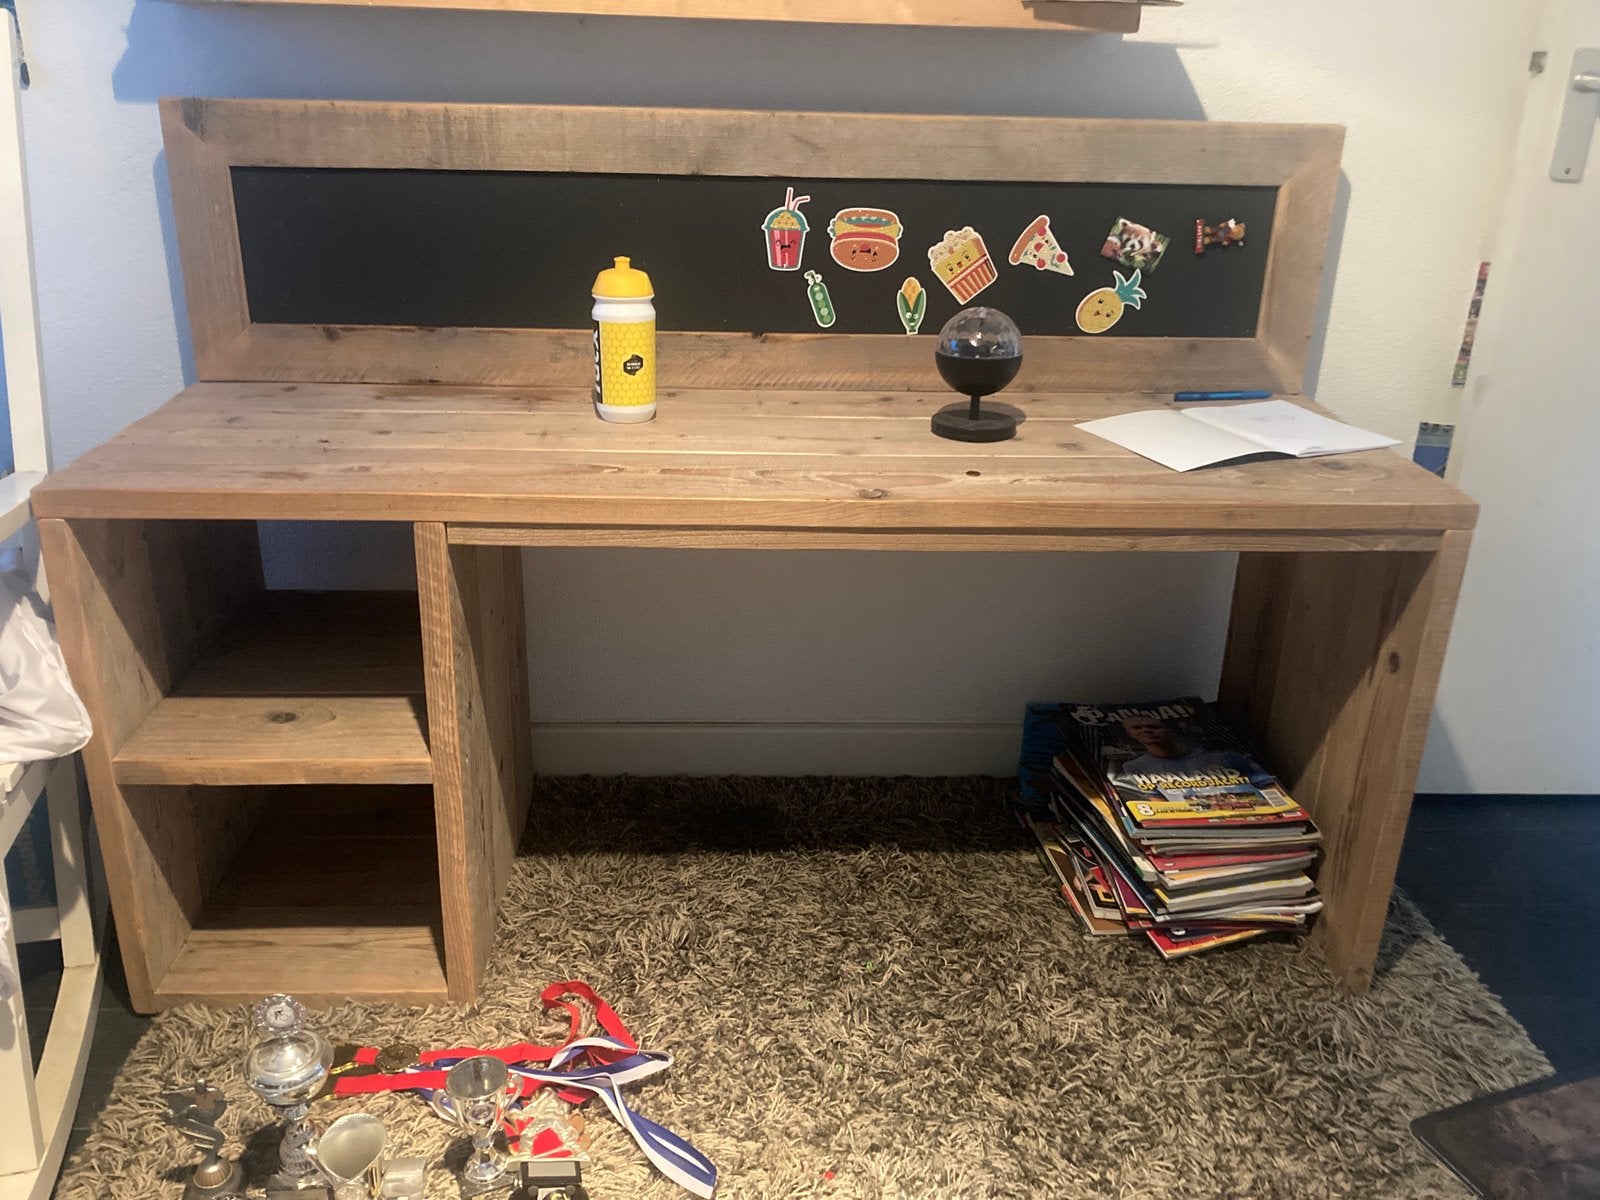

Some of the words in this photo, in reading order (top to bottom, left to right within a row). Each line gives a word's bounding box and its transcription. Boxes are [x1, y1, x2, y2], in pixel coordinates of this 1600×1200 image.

[1134, 768, 1241, 783] HAALAND
[1137, 782, 1156, 791] OP
[1136, 803, 1155, 816] 8
